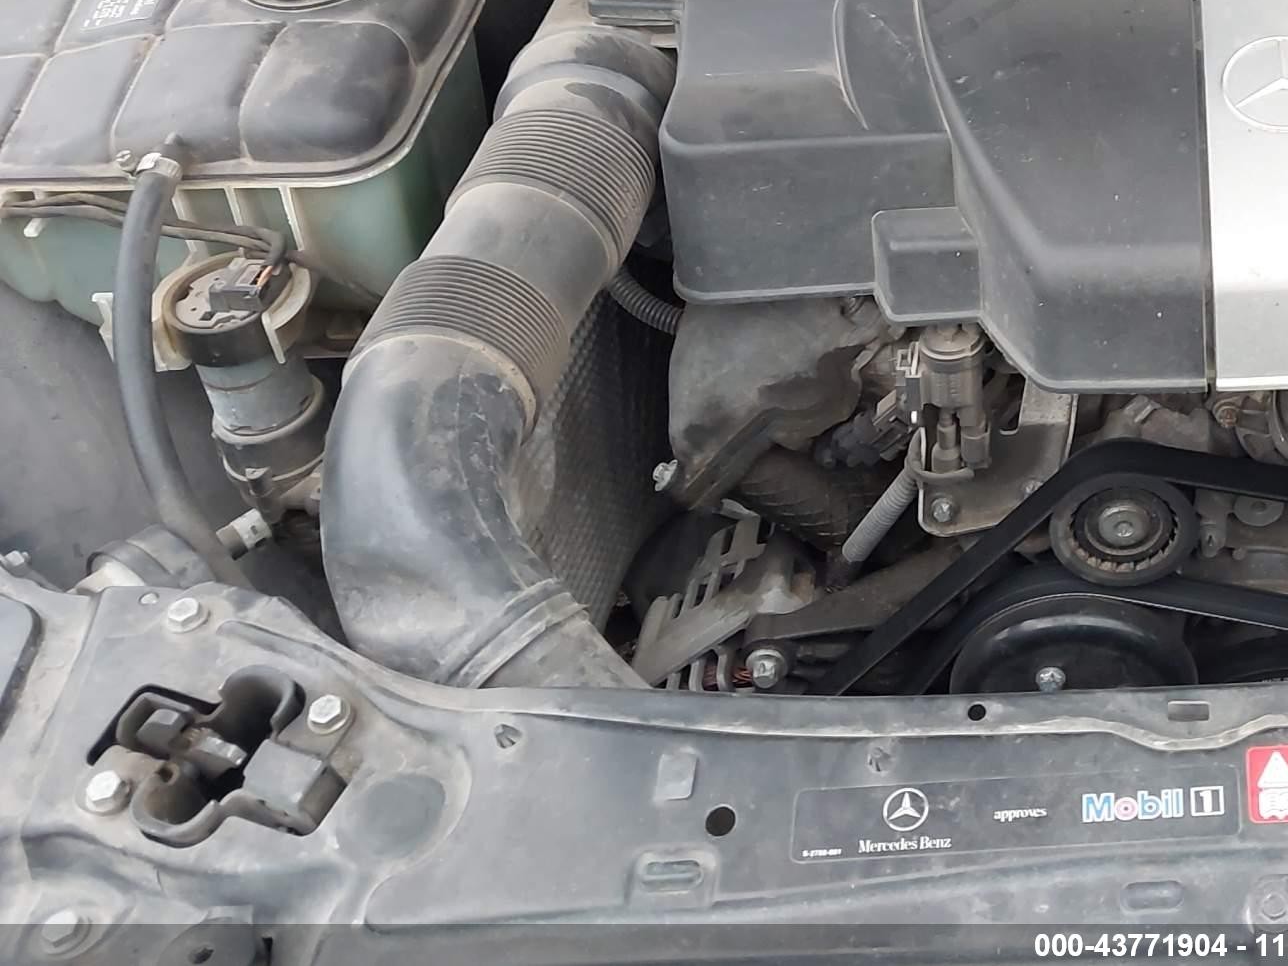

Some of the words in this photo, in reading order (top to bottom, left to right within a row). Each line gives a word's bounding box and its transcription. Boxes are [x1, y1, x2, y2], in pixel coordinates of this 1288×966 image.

[993, 808, 1048, 822] approves
[1081, 788, 1184, 824] Mobil
[858, 837, 918, 853] Mercedes
[919, 835, 952, 850] Benz
